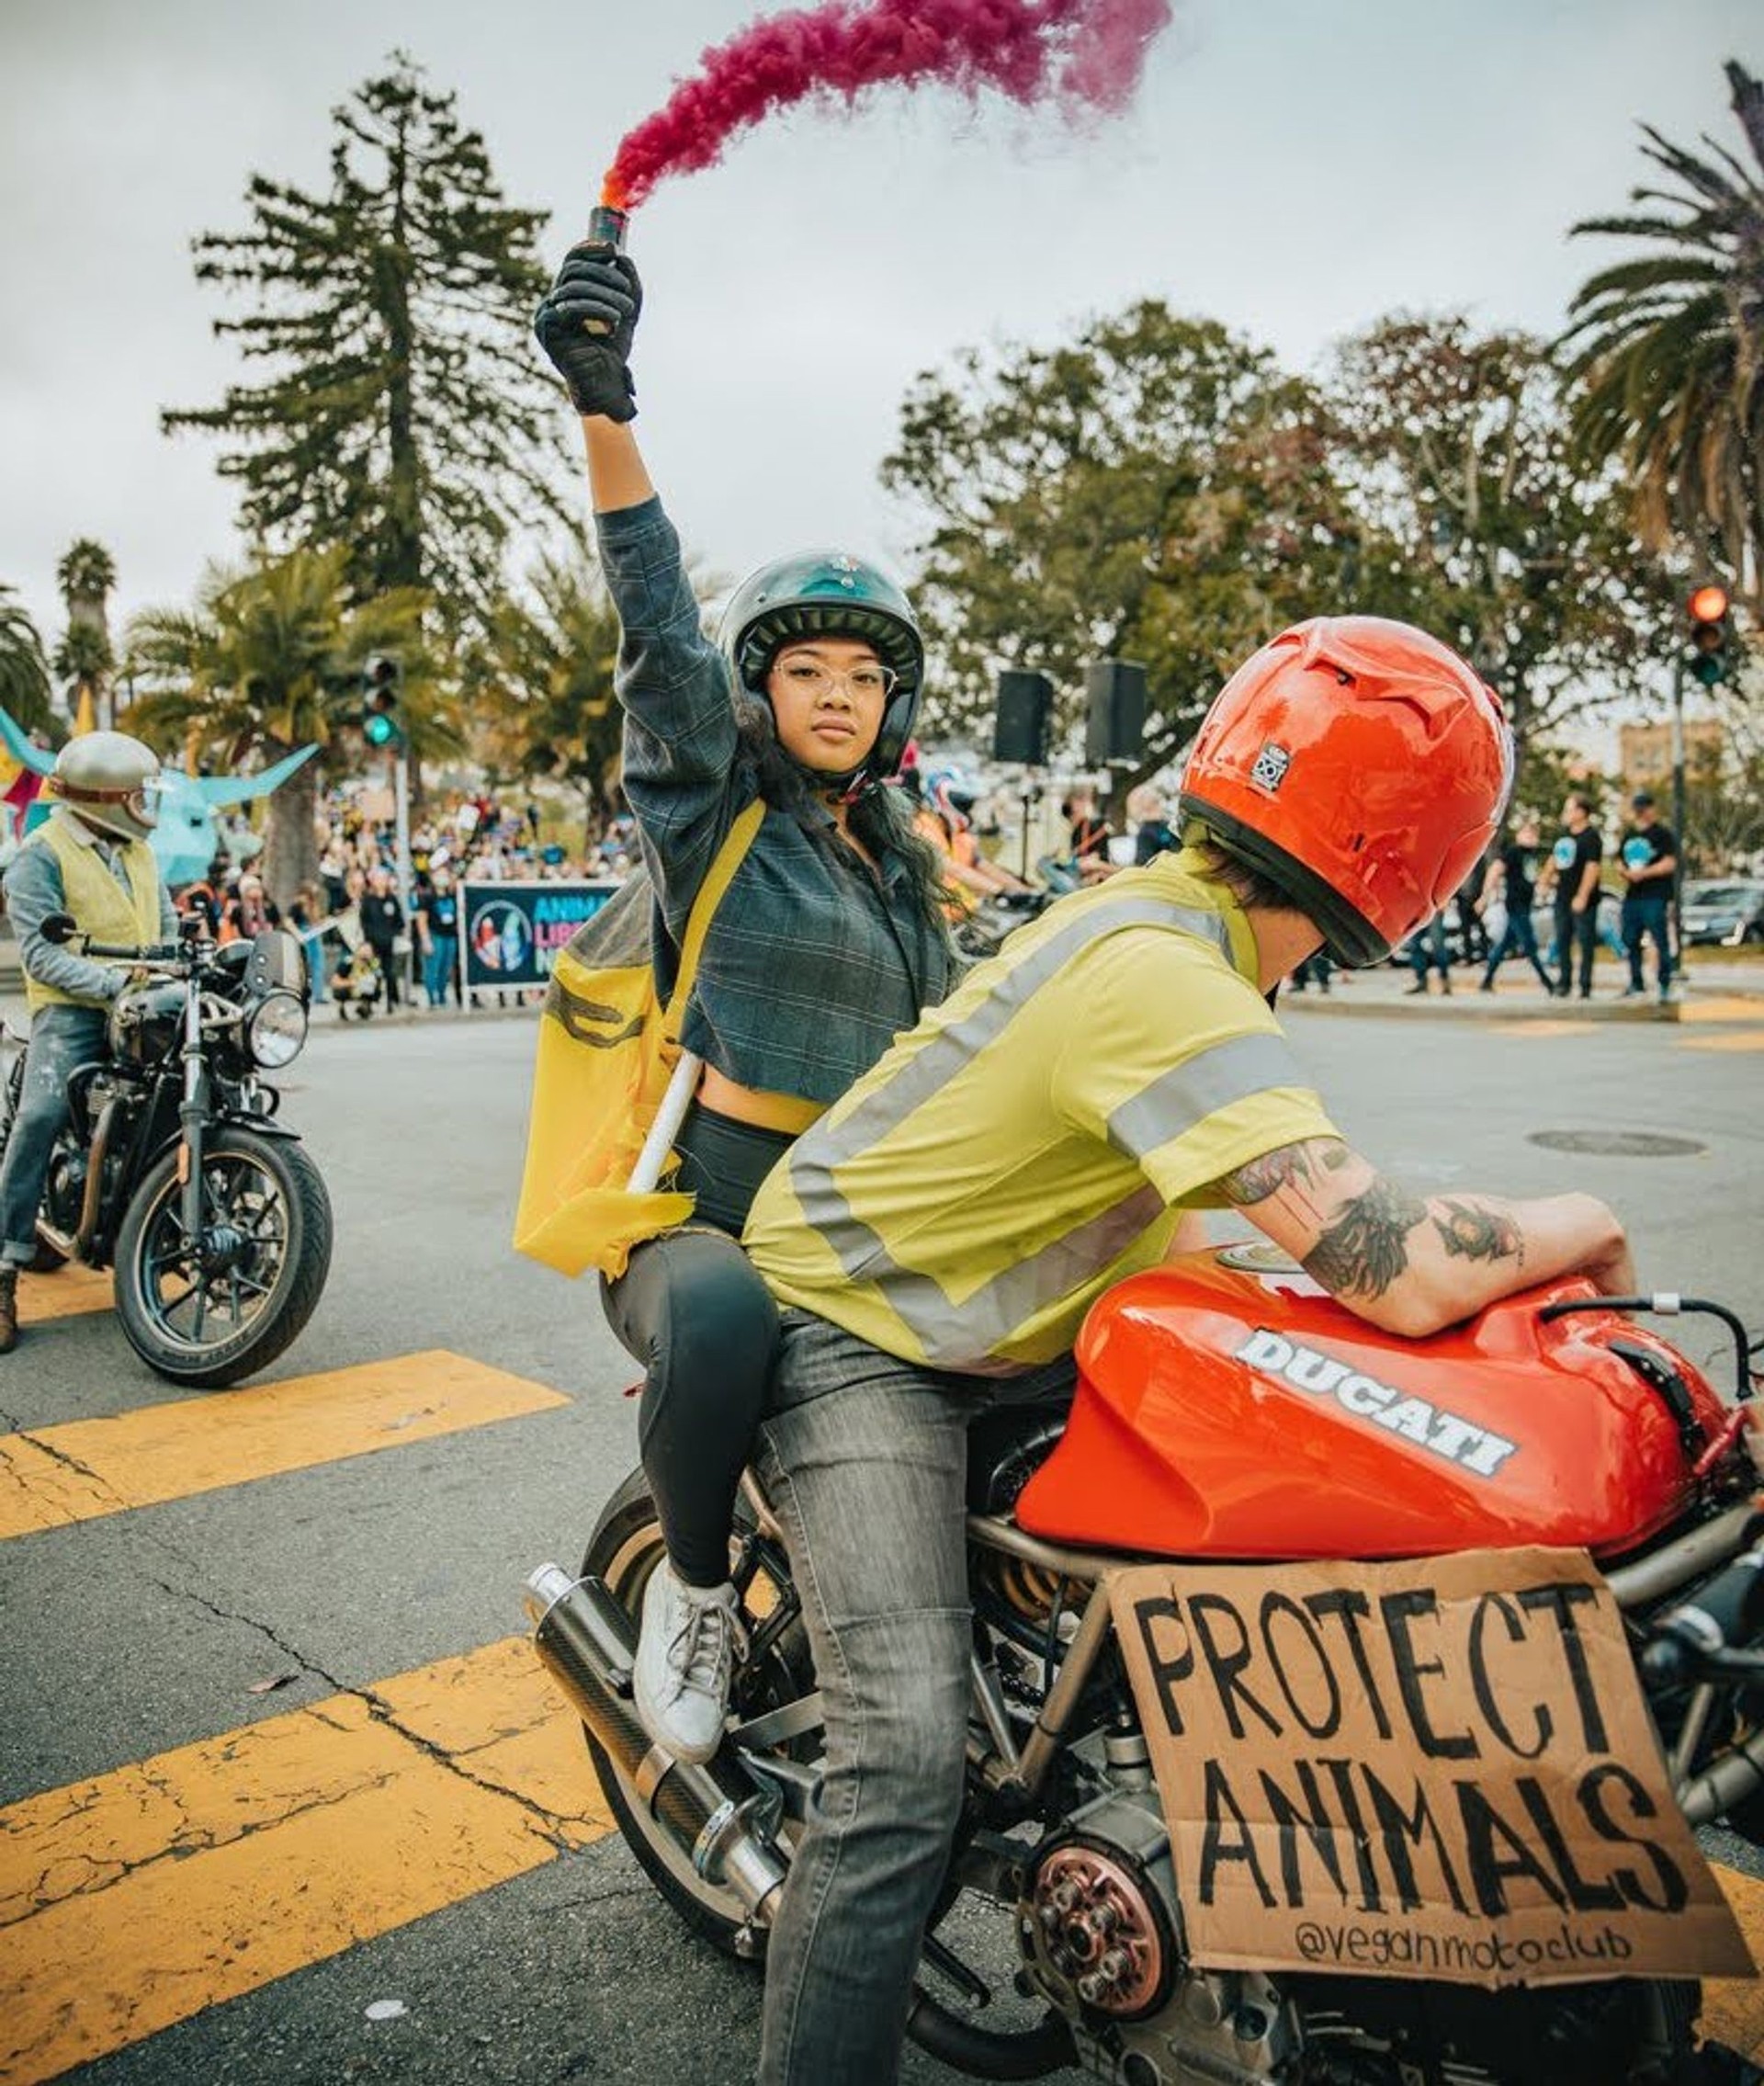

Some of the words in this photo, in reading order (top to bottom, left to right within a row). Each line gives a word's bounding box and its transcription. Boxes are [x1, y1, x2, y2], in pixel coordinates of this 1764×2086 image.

[1236, 1329, 1516, 1477] DUCATI
[1135, 1582, 1610, 1759] PROTECT
[1199, 1758, 1689, 1917] ANIMALS
[1295, 1922, 1632, 1970] @veganmotoclub
